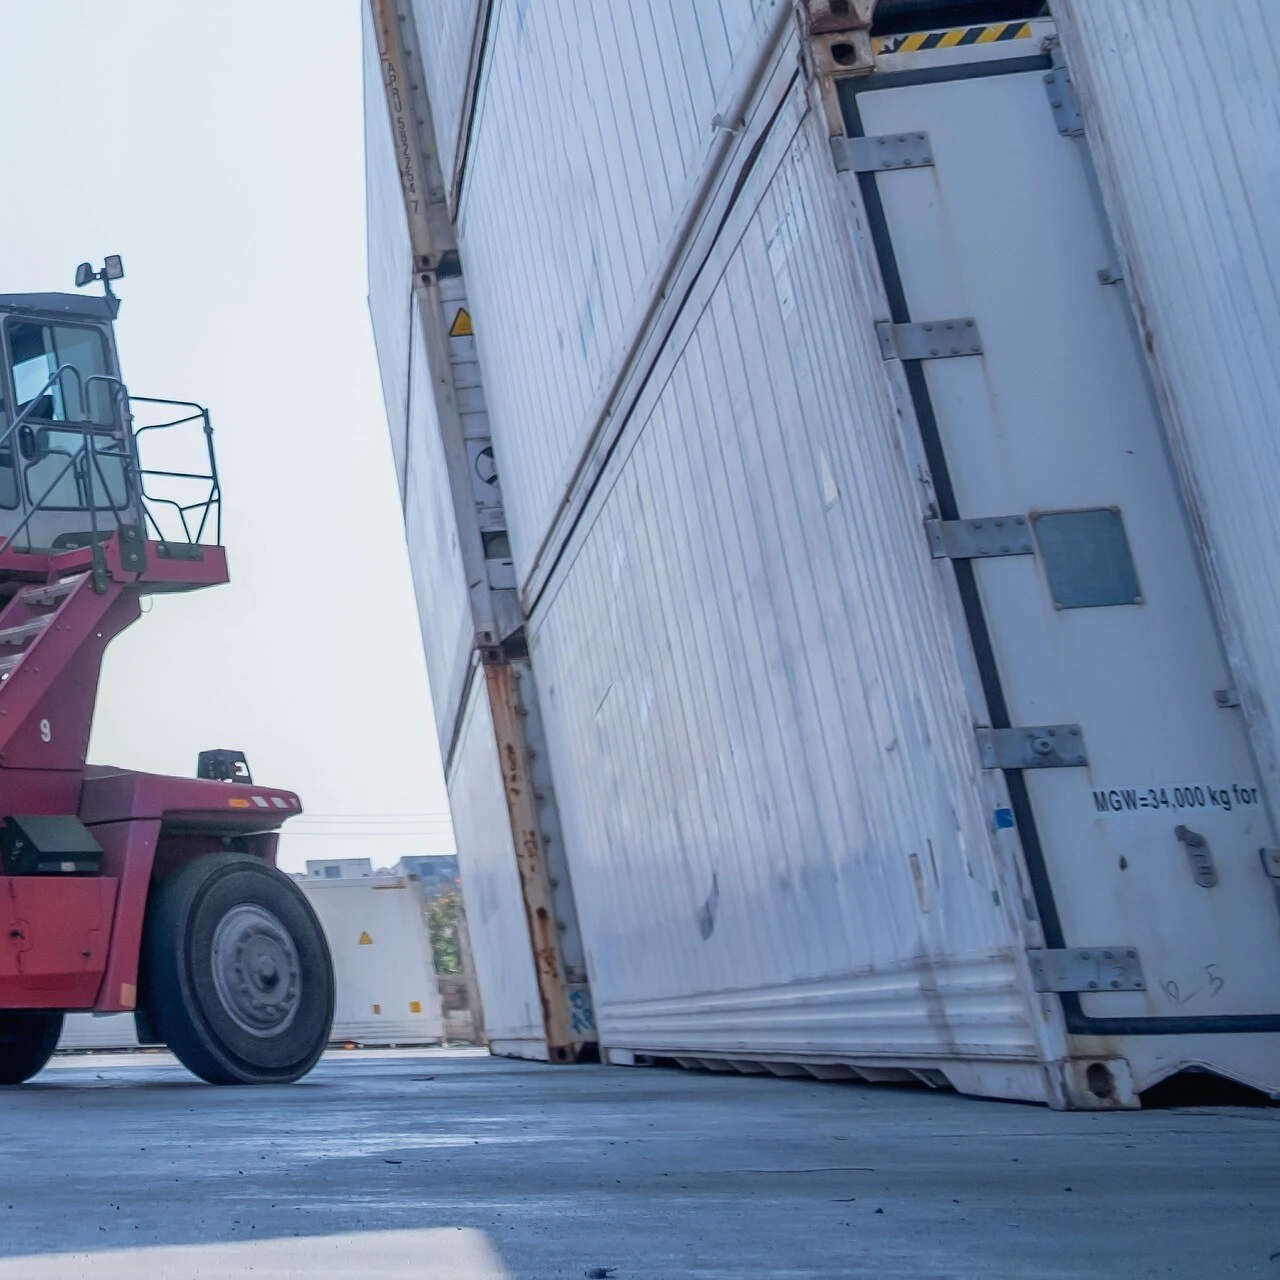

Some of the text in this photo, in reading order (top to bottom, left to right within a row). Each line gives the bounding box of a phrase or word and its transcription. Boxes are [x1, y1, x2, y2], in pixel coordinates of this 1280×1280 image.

[387, 61, 402, 113] APRU
[40, 719, 52, 743] 9
[1207, 785, 1232, 811] kg
[1232, 783, 1258, 805] for
